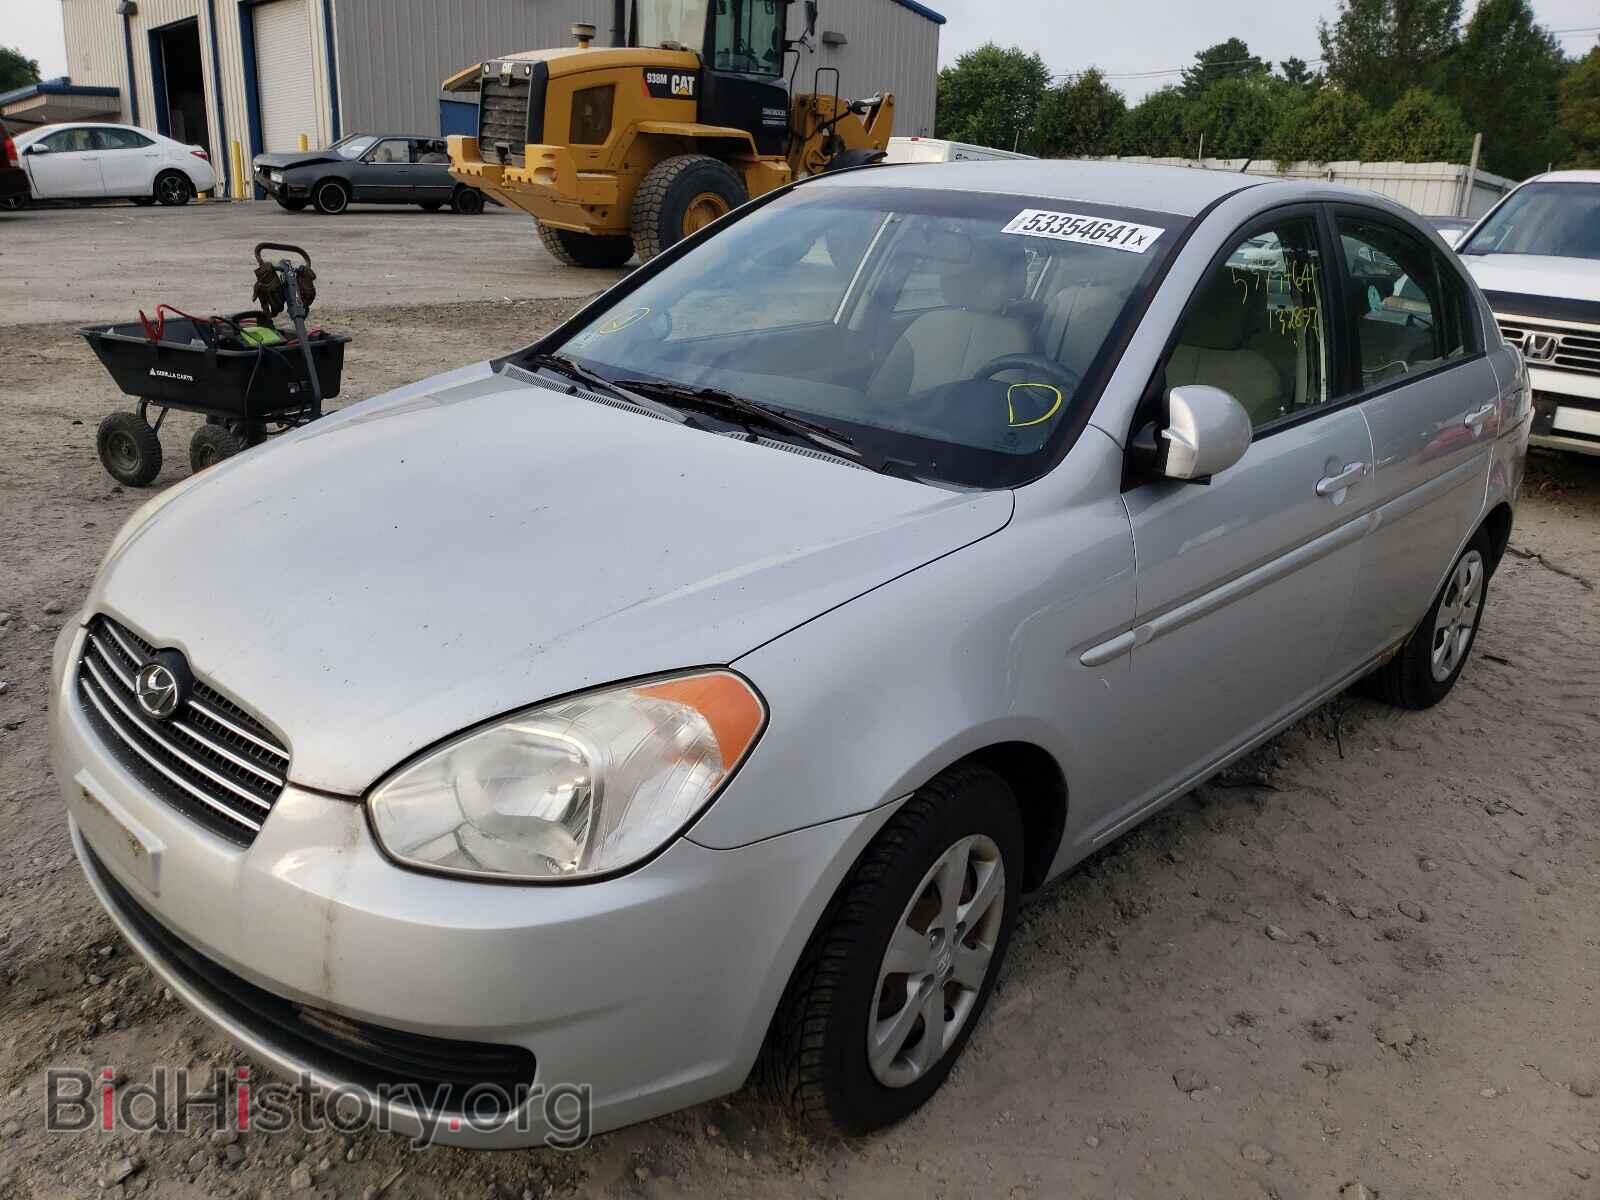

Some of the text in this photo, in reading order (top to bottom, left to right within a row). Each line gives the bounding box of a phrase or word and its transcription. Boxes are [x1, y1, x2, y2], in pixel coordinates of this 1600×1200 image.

[646, 72, 695, 96] 938M CAT
[1022, 213, 1138, 245] 53354641
